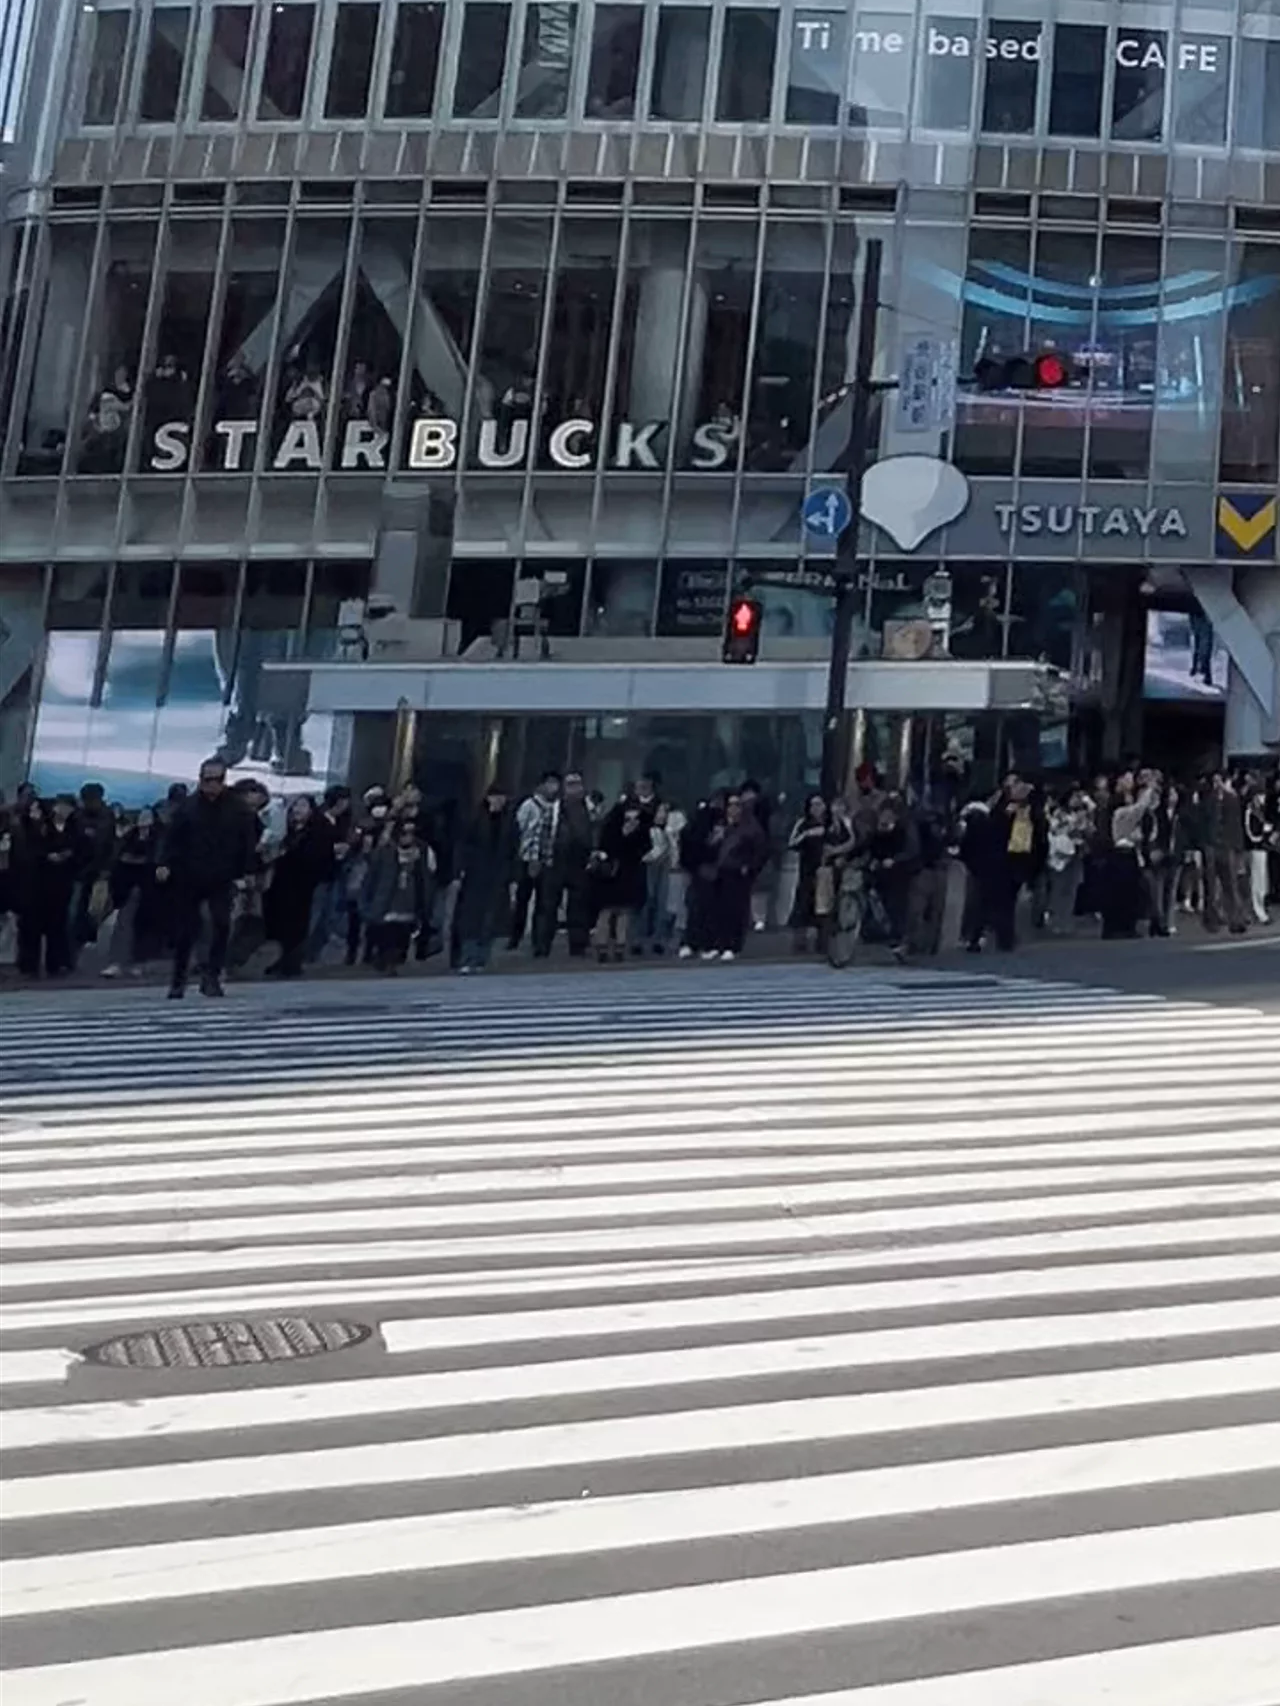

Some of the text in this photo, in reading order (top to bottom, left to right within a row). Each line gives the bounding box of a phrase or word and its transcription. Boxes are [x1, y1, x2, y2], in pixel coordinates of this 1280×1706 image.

[796, 21, 1218, 73] Time based CAFE
[150, 417, 737, 471] STARBUCKS
[994, 504, 1187, 536] TSUTAYA
